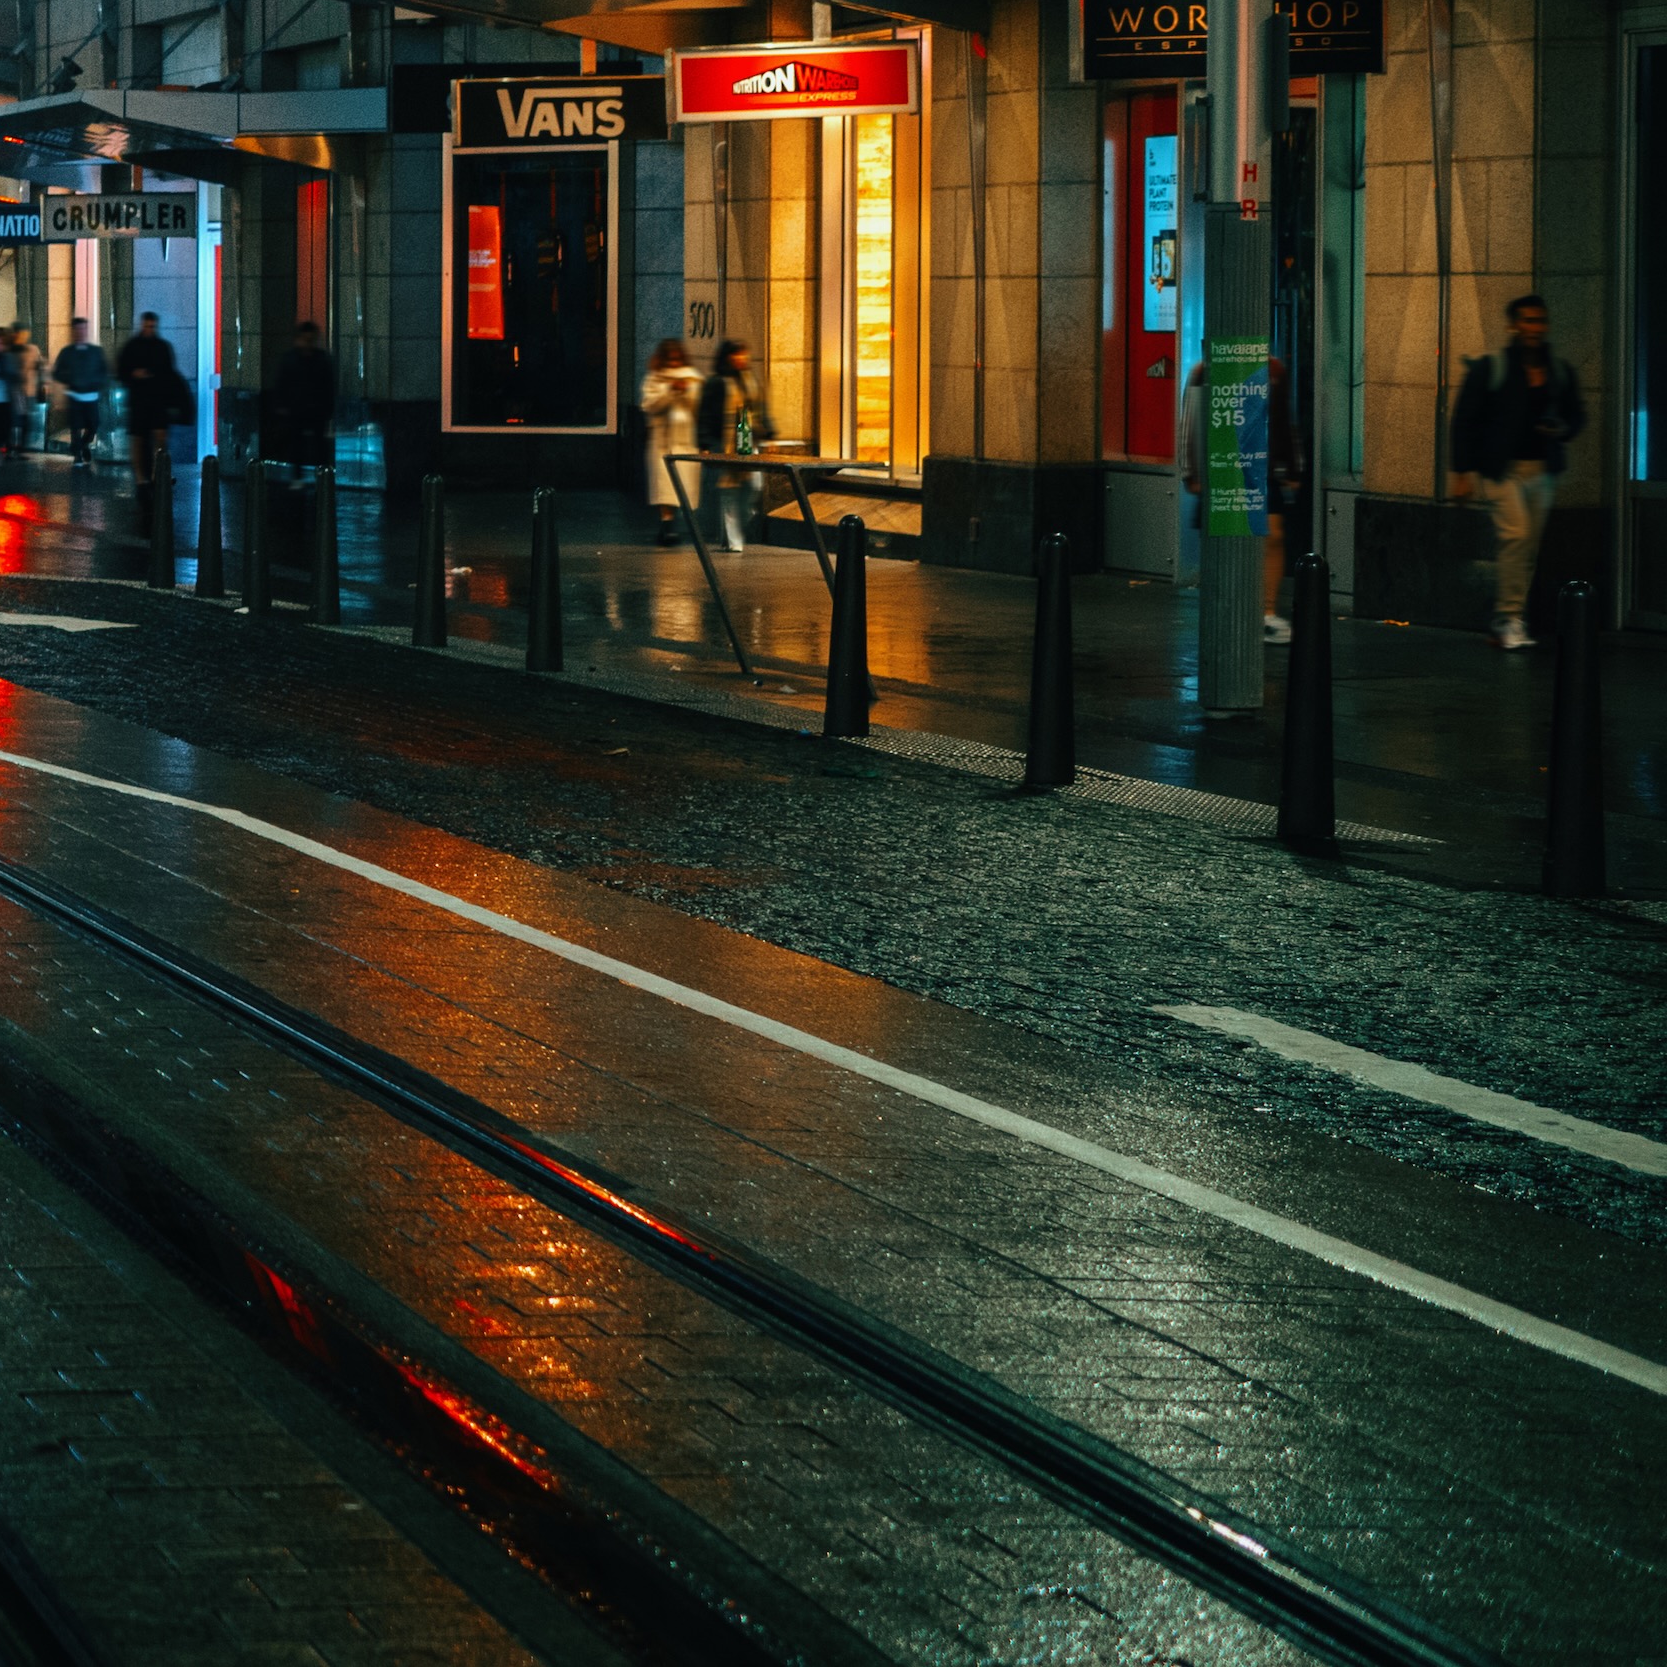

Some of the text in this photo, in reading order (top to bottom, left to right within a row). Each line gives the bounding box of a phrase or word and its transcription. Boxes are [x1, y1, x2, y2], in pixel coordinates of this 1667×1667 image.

[1108, 1, 1360, 33] WORHOP
[798, 91, 857, 103] EXPRESS
[496, 86, 626, 138] VANS
[53, 203, 187, 232] CRUMPLER
[689, 302, 715, 338] 500
[1212, 381, 1268, 399] nothing
[1212, 396, 1247, 408] over
[1212, 409, 1246, 429] $15
